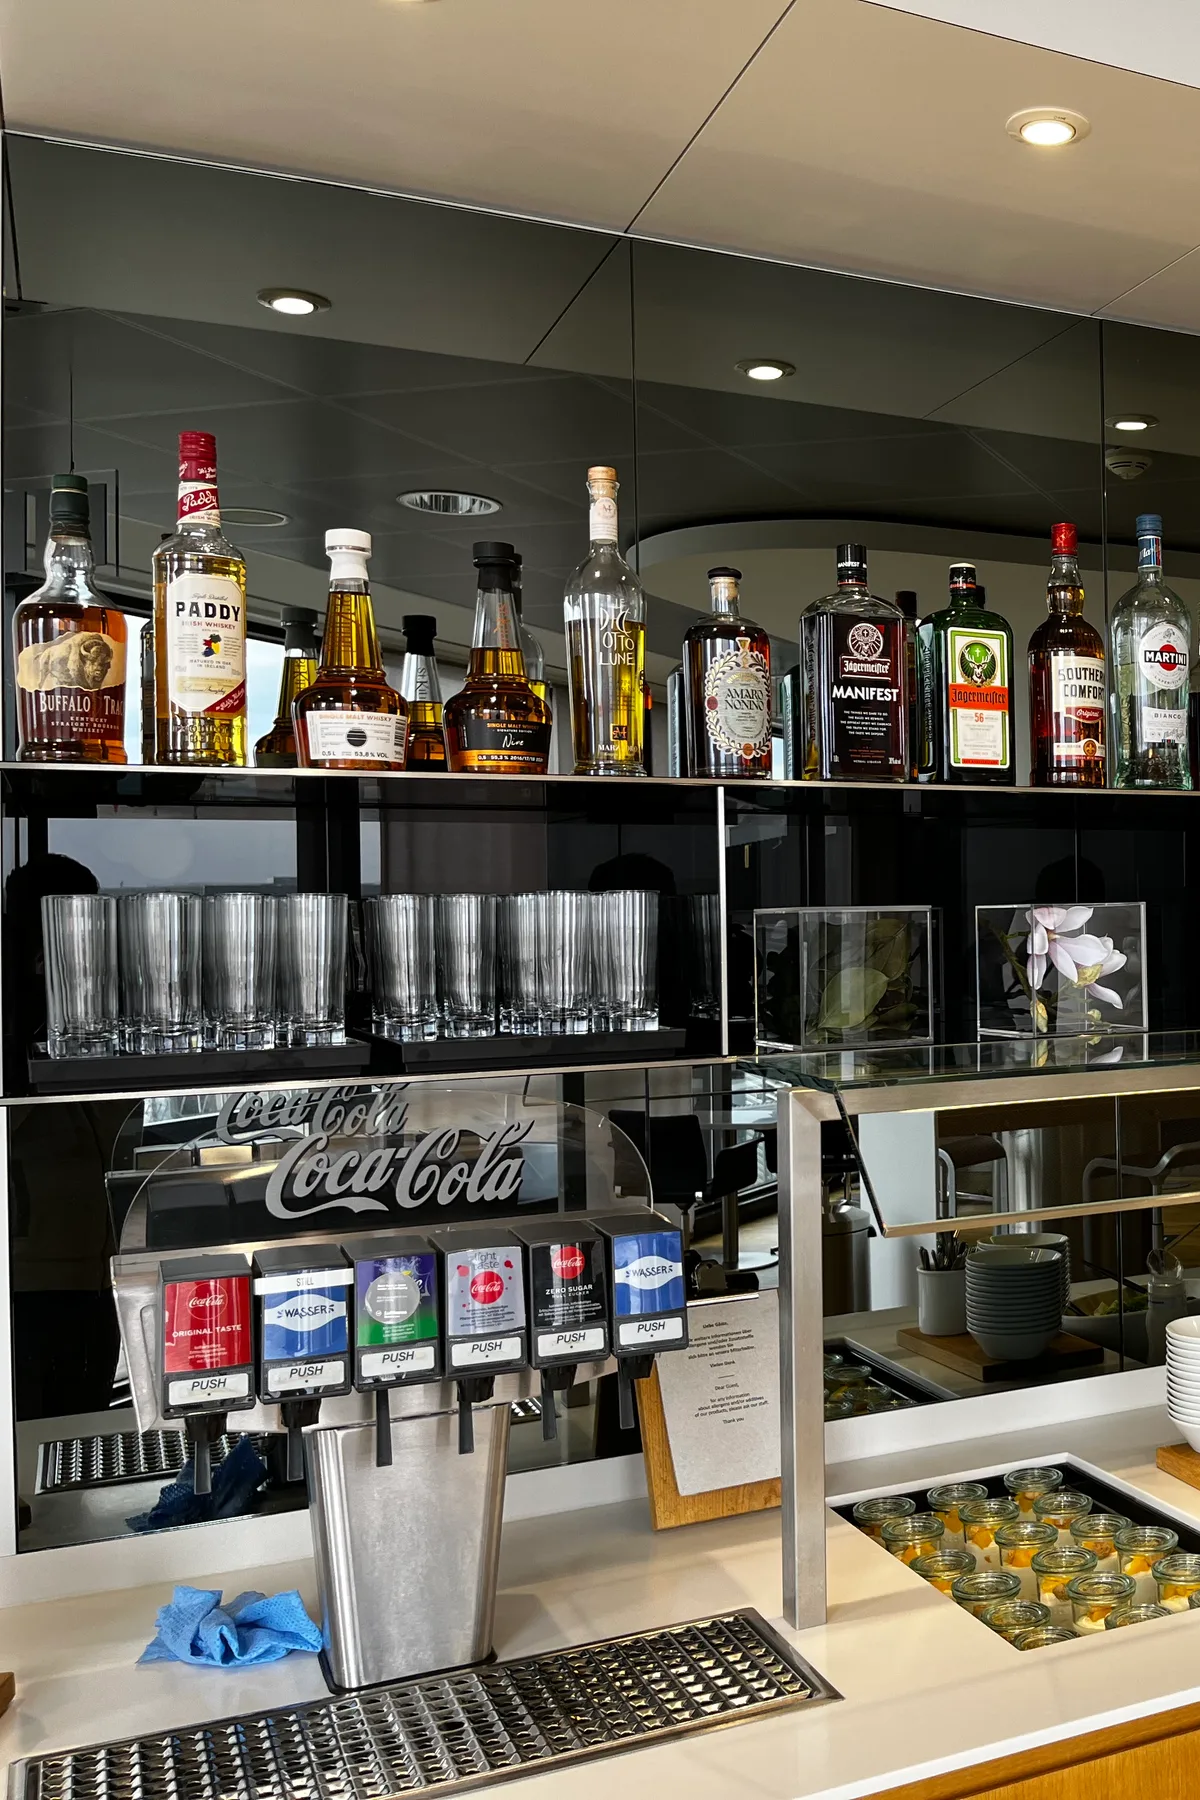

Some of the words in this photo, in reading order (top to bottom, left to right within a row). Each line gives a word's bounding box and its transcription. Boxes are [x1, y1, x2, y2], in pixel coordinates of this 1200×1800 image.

[182, 490, 217, 511] Paddy
[176, 601, 240, 622] PADDY
[205, 621, 236, 630] WHISKEY
[598, 652, 635, 666] LUNE
[1145, 651, 1186, 665] MARTINI
[725, 688, 763, 700] AMARO
[832, 685, 899, 701] MANIFEST
[39, 692, 91, 713] BUFFALO
[725, 699, 764, 711] NONINO
[974, 713, 984, 723] 56
[1077, 708, 1100, 718] Original
[265, 1119, 535, 1219] Coca-Cola
[553, 1256, 584, 1269] Coca-Cola
[632, 1265, 667, 1277] WASSER
[296, 1277, 315, 1287] STILL
[471, 1280, 502, 1294] Coca-Cola
[545, 1287, 567, 1295] ZERO
[567, 1284, 593, 1293] SUGAR
[189, 1294, 225, 1309] Coca-Cola
[285, 1304, 328, 1319] WASSER
[172, 1327, 213, 1338] ORIGINAL
[215, 1324, 242, 1333] TASTE
[637, 1321, 666, 1333] PUSH
[556, 1332, 586, 1344] PUSH
[471, 1341, 503, 1353] PUSH
[381, 1350, 415, 1364] PUSH
[289, 1365, 324, 1379] PUSH
[191, 1377, 227, 1392] PUSH
